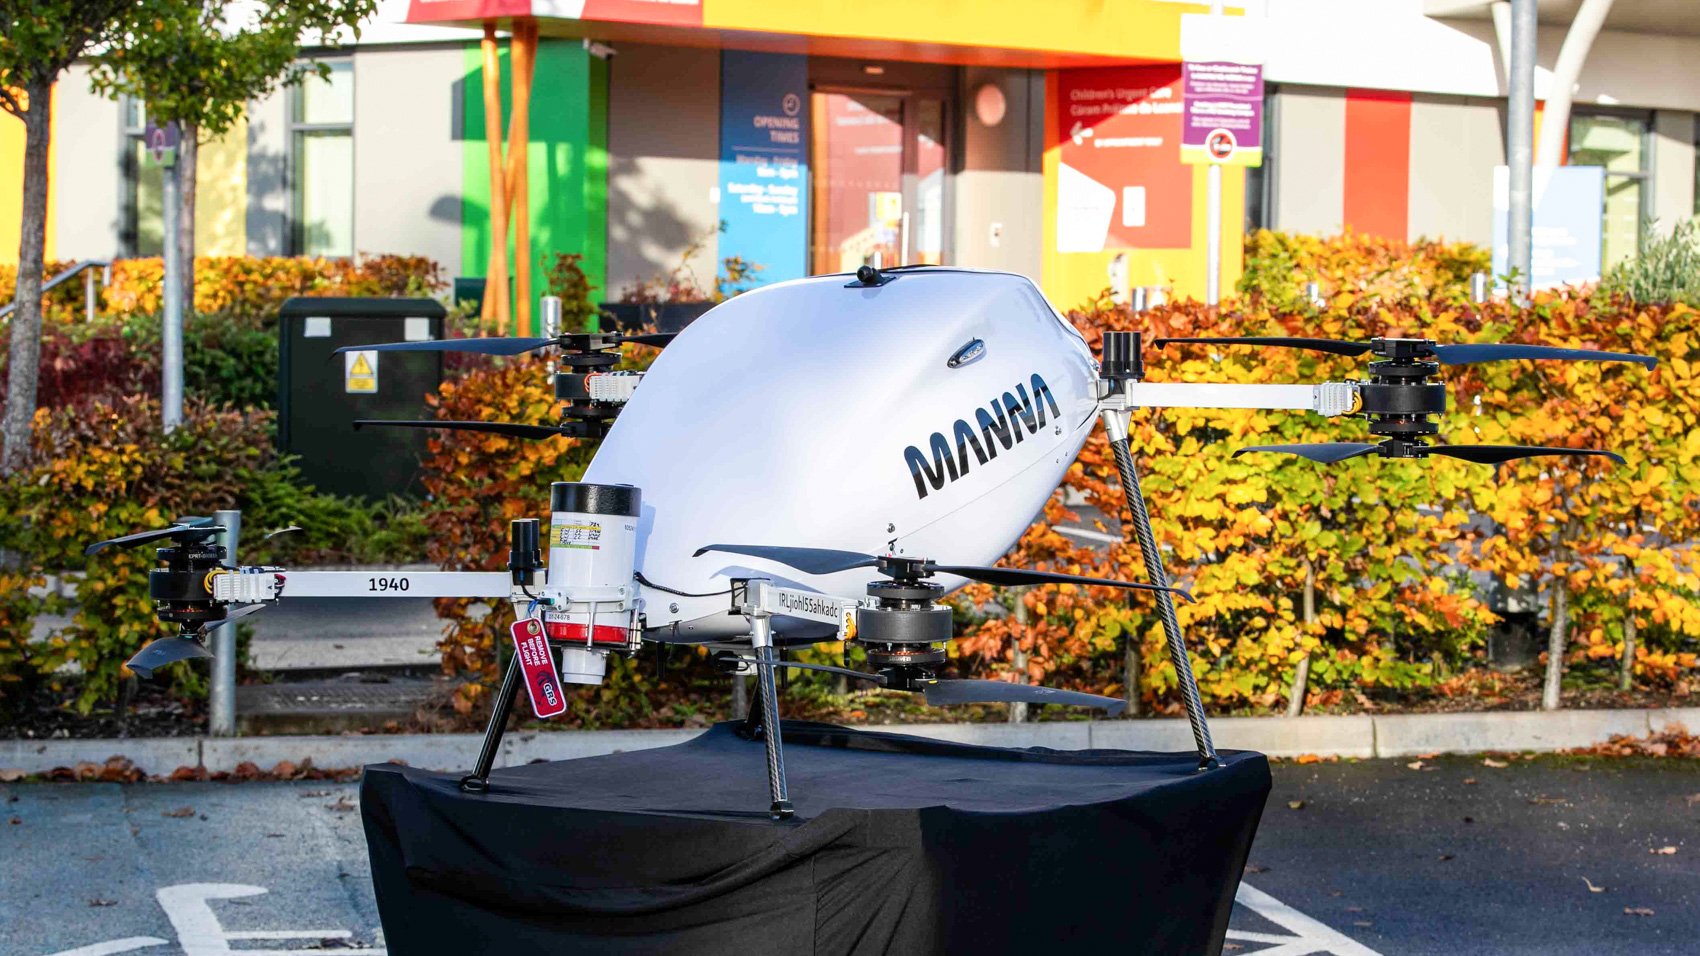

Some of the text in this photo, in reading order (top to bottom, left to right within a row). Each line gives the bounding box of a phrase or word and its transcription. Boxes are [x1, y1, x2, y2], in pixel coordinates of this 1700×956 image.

[753, 115, 799, 129] OPENING
[769, 129, 799, 143] TIMES
[904, 373, 1060, 500] MANNA
[369, 577, 410, 591] 1940
[520, 641, 533, 666] FLIGHT
[527, 638, 541, 667] BEFORE
[535, 635, 548, 665] REMOVE
[543, 682, 557, 706] GRS
